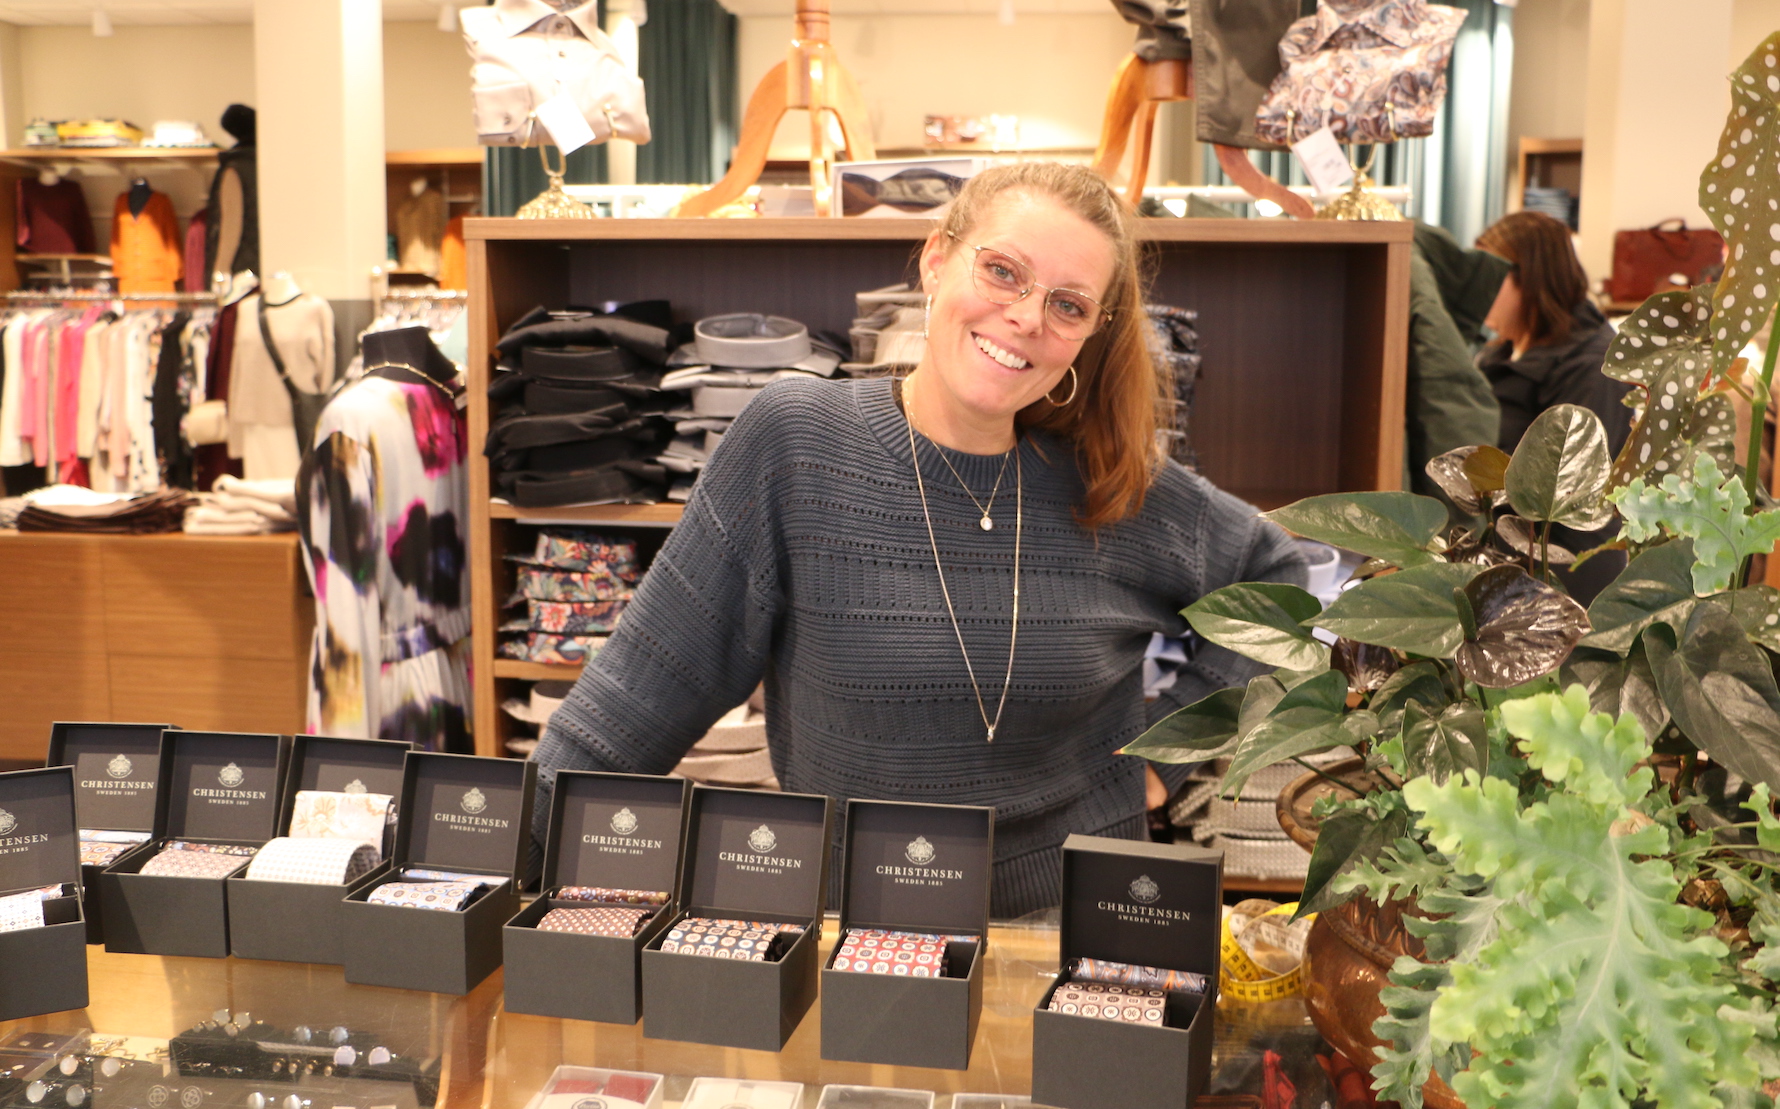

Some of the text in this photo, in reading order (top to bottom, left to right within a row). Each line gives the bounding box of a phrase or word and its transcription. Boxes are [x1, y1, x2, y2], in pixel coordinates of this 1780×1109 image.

[81, 780, 154, 790] CHRISTENSEN
[193, 788, 266, 800] CHRISTENSEN
[434, 813, 509, 828] CHRISTENSEN
[0, 833, 48, 847] TENSEN
[583, 835, 662, 849] CHRISTENSEN
[719, 852, 801, 868] CHRISTENSEN
[736, 864, 765, 873] SWEDEN
[876, 865, 963, 879] CHRISTENSEN
[895, 877, 924, 885] SWEDEN
[1097, 901, 1190, 921] CHRISTENSEN
[1118, 914, 1150, 923] SWEDEN
